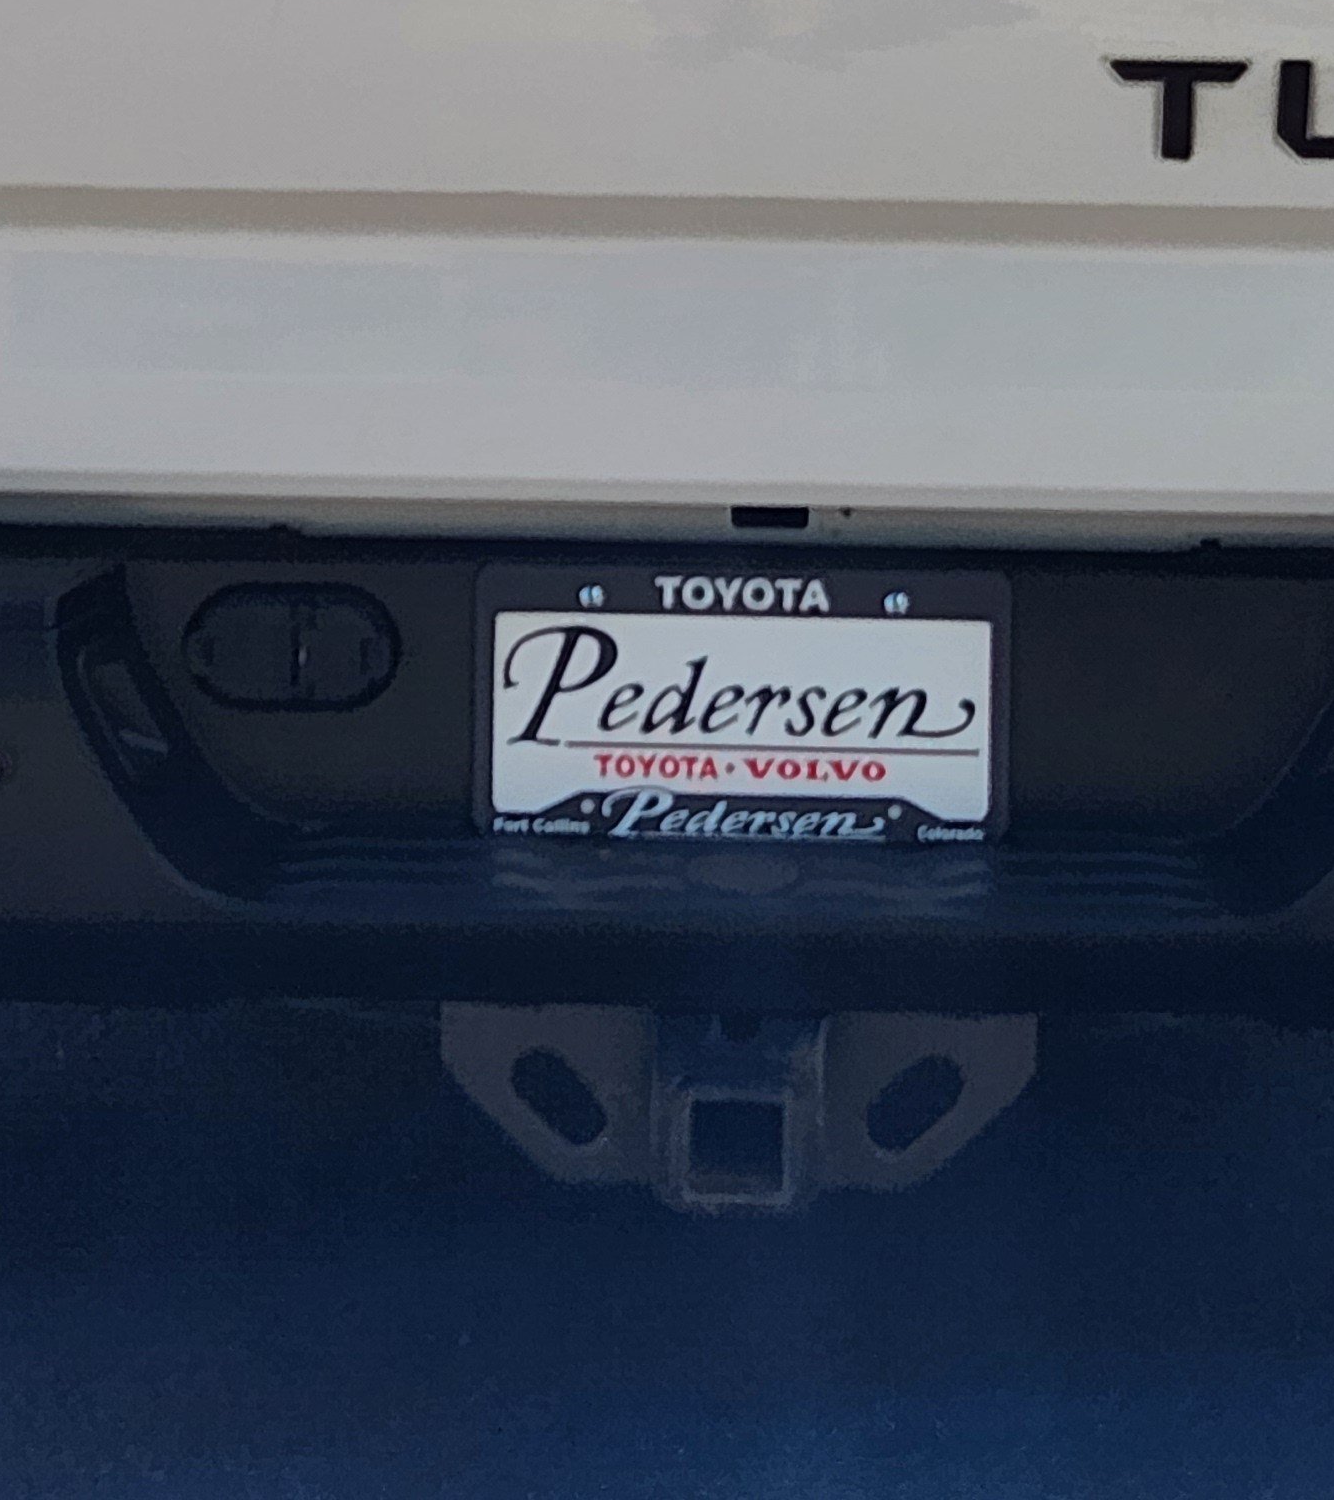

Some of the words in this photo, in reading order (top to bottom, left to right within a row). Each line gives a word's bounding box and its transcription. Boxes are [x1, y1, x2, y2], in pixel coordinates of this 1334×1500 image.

[655, 575, 831, 613] TOYOTA
[503, 625, 976, 747] Pedersen
[593, 753, 720, 781] TOYOTA
[745, 757, 887, 783] VOLVO
[601, 786, 886, 839] Pedersen
